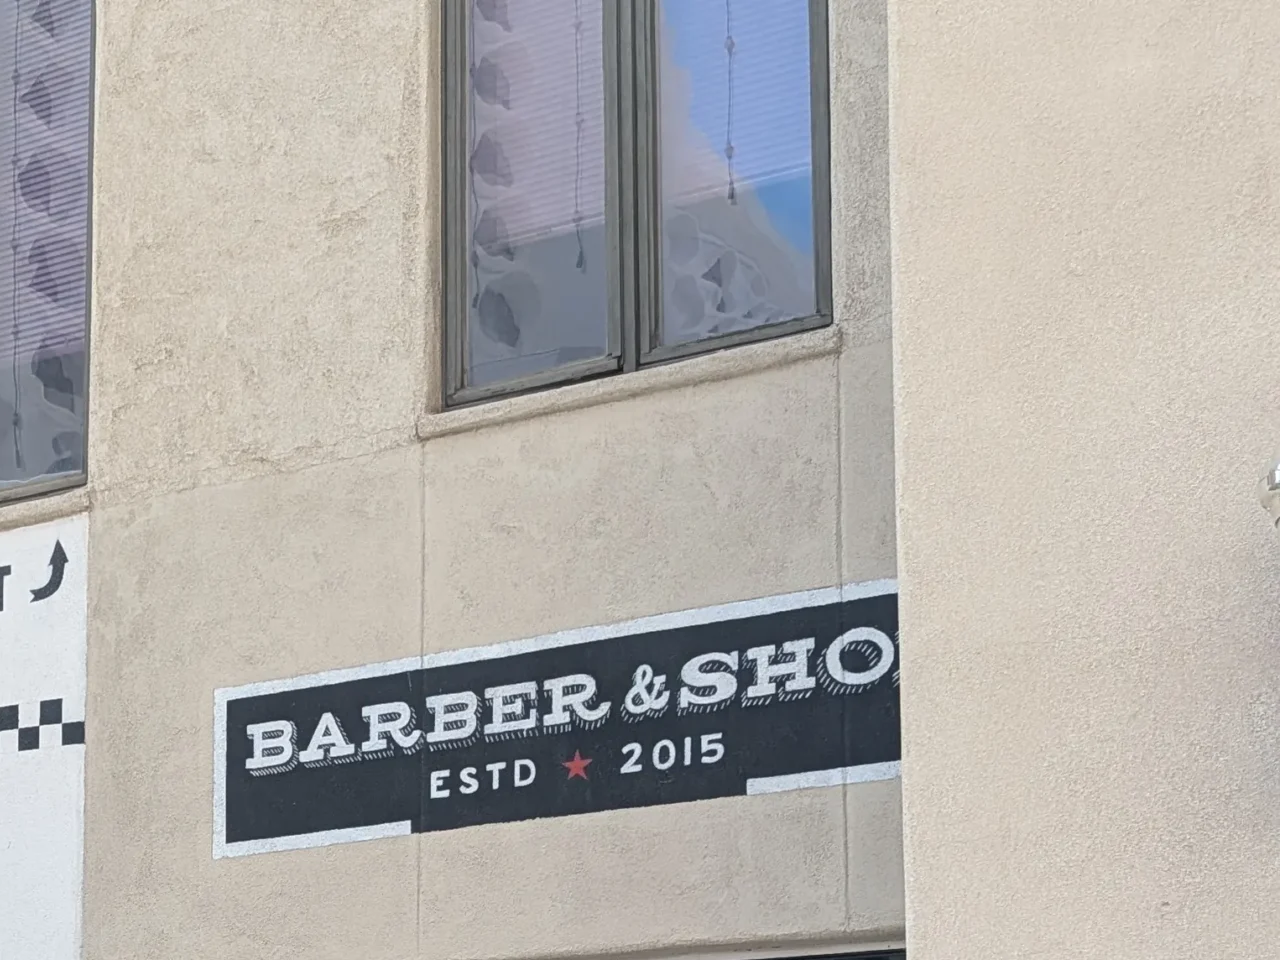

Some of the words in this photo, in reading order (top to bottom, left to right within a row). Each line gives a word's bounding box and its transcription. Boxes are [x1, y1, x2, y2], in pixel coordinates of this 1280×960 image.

[245, 673, 612, 775] BARBER
[678, 626, 898, 712] SHO
[430, 759, 536, 799] ESTD
[620, 732, 725, 774] 2015
